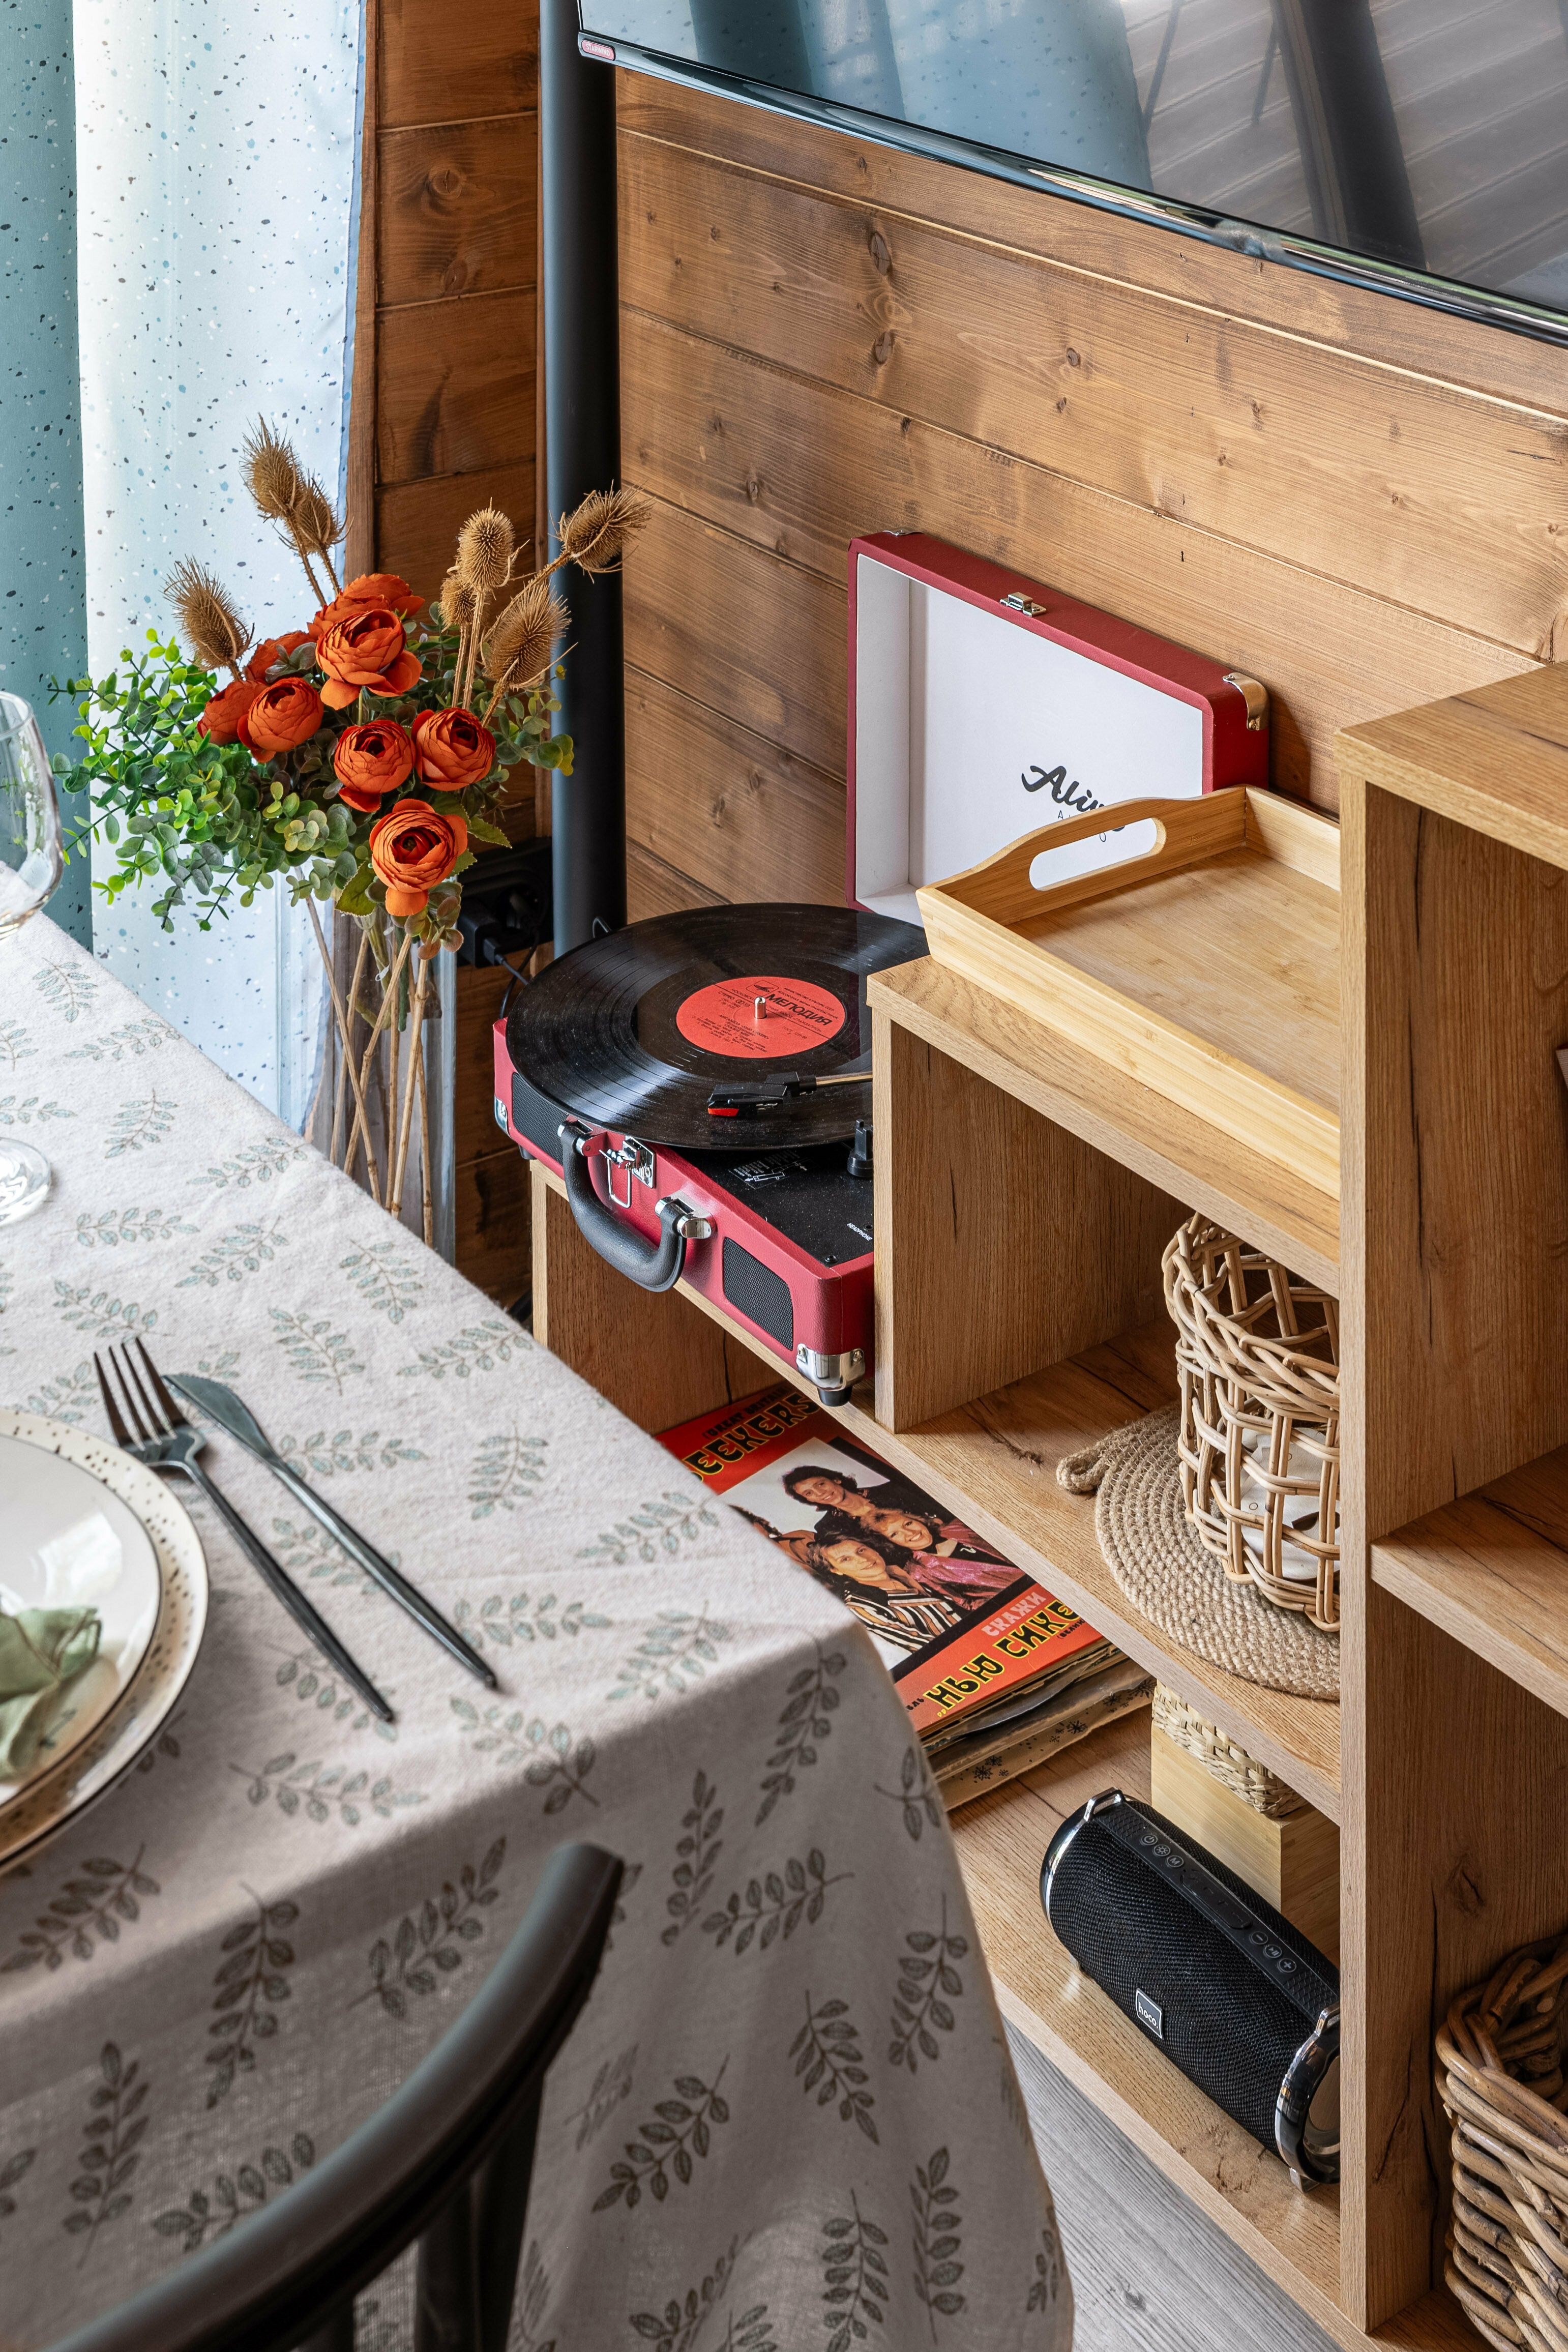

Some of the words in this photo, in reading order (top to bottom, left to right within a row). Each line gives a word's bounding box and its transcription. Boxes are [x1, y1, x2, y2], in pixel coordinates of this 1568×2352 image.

[586, 43, 610, 56] STARWIND
[1021, 766, 1105, 812] Ali
[765, 994, 833, 1025] МЕЛОДИЯ
[847, 1223, 873, 1241] HEADPHONE
[982, 1592, 1047, 1636] СКАЖИ
[992, 1599, 1081, 1659] СИКЕ
